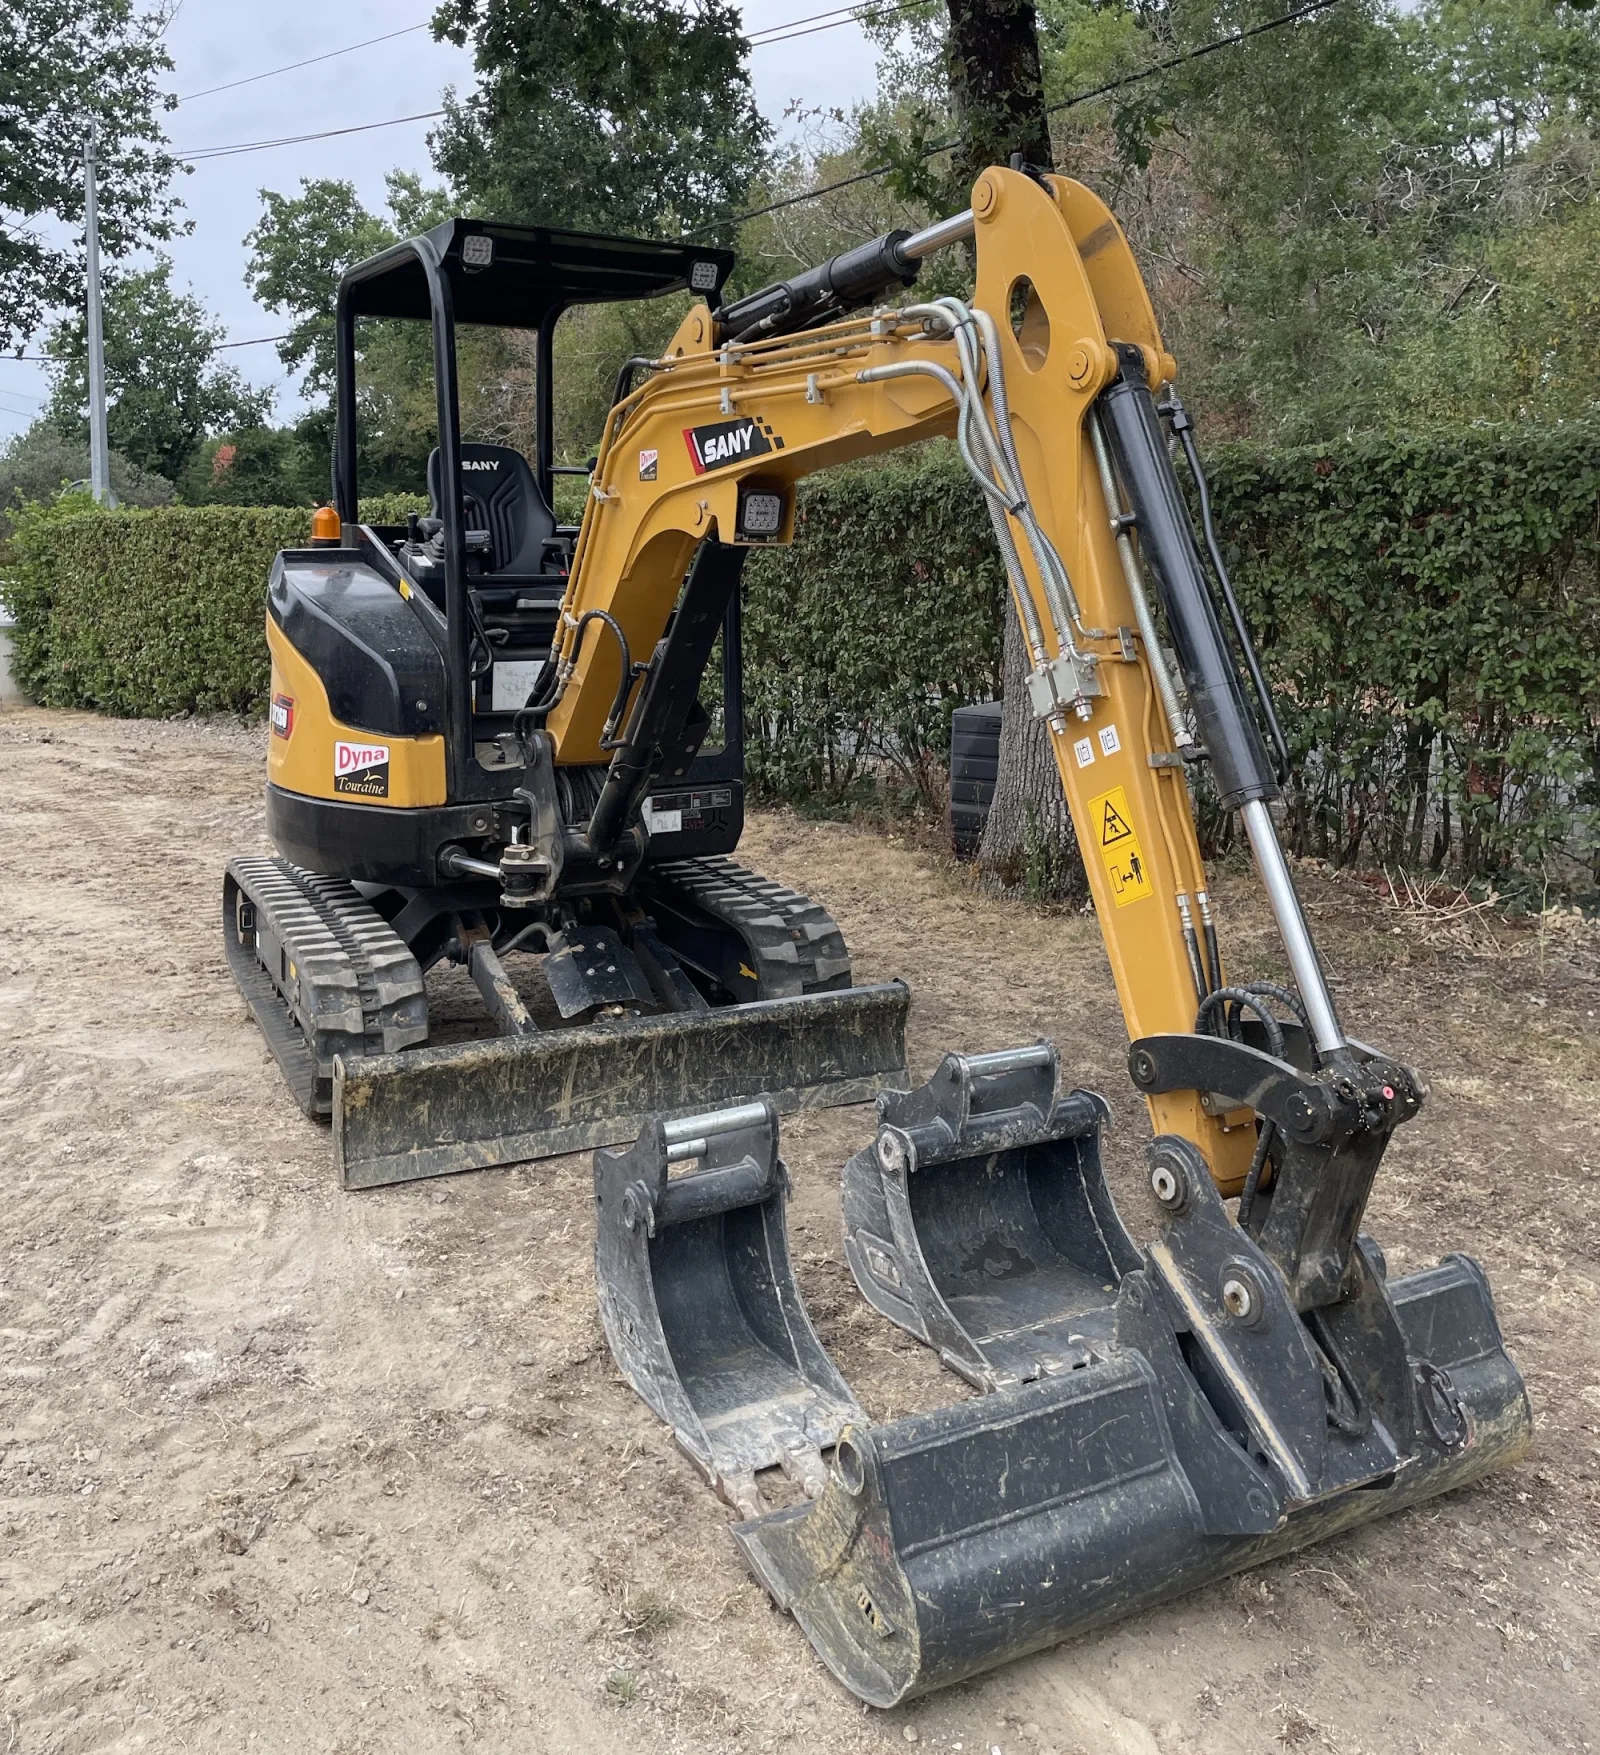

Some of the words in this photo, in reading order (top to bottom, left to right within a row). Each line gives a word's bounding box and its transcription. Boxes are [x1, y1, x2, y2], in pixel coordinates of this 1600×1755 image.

[704, 425, 754, 464] SANY
[461, 460, 500, 471] SANY
[339, 745, 385, 771] Dyna
[337, 776, 385, 795] Touraine
